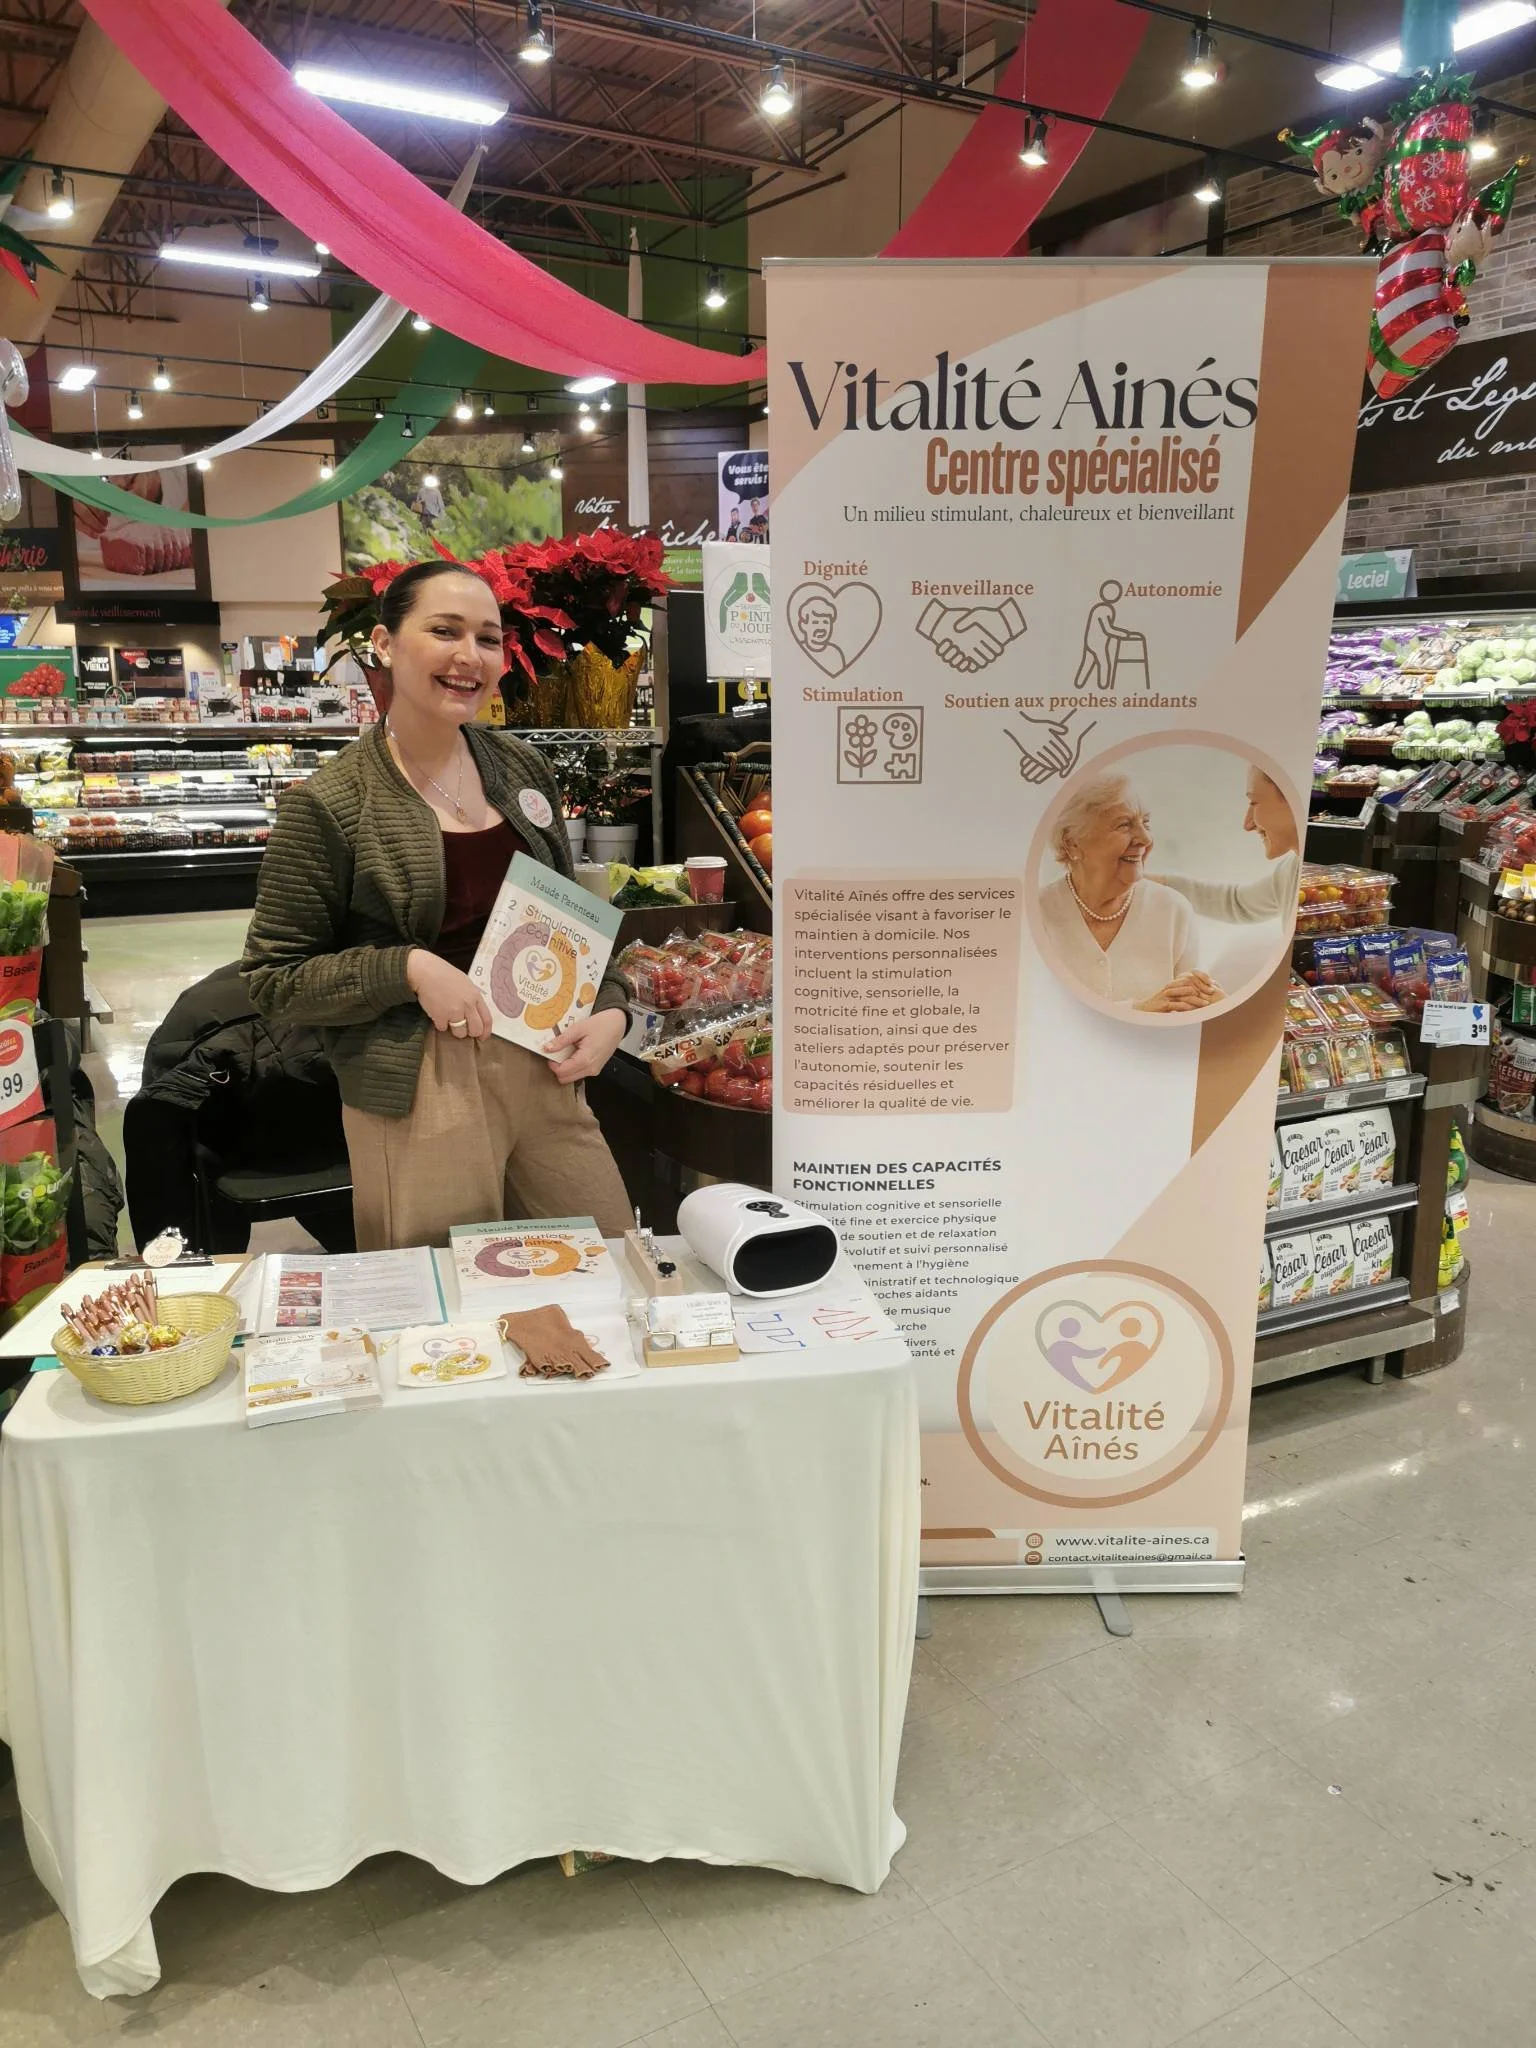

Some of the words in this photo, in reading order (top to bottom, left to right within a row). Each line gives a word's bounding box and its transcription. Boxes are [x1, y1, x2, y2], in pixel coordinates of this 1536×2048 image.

[787, 350, 1042, 432] Vitalité
[1053, 357, 1259, 430] Ainés
[1437, 438, 1479, 463] du
[728, 465, 750, 475] Vous
[926, 436, 1039, 495] Centre
[1046, 433, 1221, 505] spécialisé
[574, 497, 620, 514] Votre
[844, 505, 870, 522] Un
[874, 505, 925, 522] milieu
[931, 505, 1013, 524] stimulant,
[1019, 505, 1110, 522] chaleureux
[1116, 506, 1132, 521] et
[1138, 504, 1234, 521] bienveillant
[803, 560, 868, 580] Dignité
[912, 580, 1034, 597] Bienveillance
[1125, 581, 1222, 597] Autonomie
[802, 687, 904, 703] Stimulation
[944, 694, 1011, 709] Soutien
[1014, 697, 1044, 709] aux
[1049, 693, 1118, 711] proches
[1122, 693, 1197, 709] aindants
[530, 877, 560, 900] Maude
[560, 892, 600, 924] Parenteau
[795, 889, 845, 901] Vitalité
[892, 889, 924, 901] offre
[929, 889, 954, 900] des
[958, 888, 1015, 899] services
[795, 909, 871, 922] spécialisée
[876, 910, 918, 921] visant
[922, 908, 930, 920] à
[934, 909, 995, 920] favoriser
[1000, 908, 1011, 919] le
[525, 904, 589, 945] Stimulation
[526, 923, 578, 959] Cognitive
[795, 929, 858, 941] maintien
[862, 930, 870, 941] à
[875, 929, 938, 940] domicile.
[944, 928, 970, 939] Nos
[795, 948, 888, 960] interventions
[892, 948, 997, 961] personnalisées
[795, 966, 852, 979] incluent
[856, 968, 867, 979] la
[872, 967, 952, 979] stimulation
[795, 986, 862, 1000] cognitive,
[866, 986, 943, 998] sensorielle,
[948, 985, 959, 996] la
[795, 1006, 858, 1017] motricité
[862, 1006, 888, 1016] fine
[892, 1006, 906, 1016] et
[910, 1004, 965, 1018] globale,
[969, 1004, 980, 1015] la
[794, 1024, 882, 1037] socialisation,
[887, 1024, 918, 1035] ainsi
[922, 1026, 948, 1037] que
[953, 1023, 977, 1034] des
[794, 1043, 844, 1054] ateliers
[848, 1042, 904, 1056] adaptés
[908, 1044, 939, 1055] pour
[945, 1042, 1009, 1054] préserver
[795, 1060, 880, 1074] l'autonomie,
[884, 1061, 940, 1072] soutenir
[945, 1060, 963, 1070] les
[794, 1080, 859, 1092] capacités
[864, 1079, 936, 1091] résiduelles
[940, 1079, 954, 1089] et
[794, 1096, 859, 1109] améliorer
[864, 1099, 874, 1109] la
[879, 1097, 926, 1110] qualité
[931, 1096, 947, 1107] de
[952, 1096, 973, 1106] vie.
[1284, 1137, 1323, 1170] Caesar
[1325, 1140, 1355, 1168] César
[793, 1161, 871, 1175] MAINTIEN
[876, 1163, 908, 1174] DES
[912, 1158, 1001, 1173] CAPACITÉS
[1302, 1172, 1314, 1182] kit
[793, 1178, 935, 1192] FONCTIONNELLES
[866, 1201, 920, 1212] cognitive
[924, 1201, 935, 1209] et
[939, 1199, 1001, 1208] sensorielle
[850, 1216, 872, 1226] fine
[876, 1217, 887, 1225] et
[891, 1215, 939, 1224] exercice
[943, 1214, 997, 1228] physique
[841, 1232, 855, 1241] de
[858, 1231, 901, 1241] soutien
[906, 1231, 917, 1239] et
[921, 1230, 935, 1239] de
[939, 1229, 996, 1238] relaxation
[1354, 1224, 1391, 1257] Caesar
[889, 1247, 900, 1255] et
[904, 1245, 930, 1254] suivi
[934, 1243, 1008, 1255] personnalisé
[906, 1260, 913, 1269] à
[917, 1259, 969, 1272] l'hygiène
[1314, 1245, 1347, 1274] César
[1372, 1259, 1382, 1269] kit
[1275, 1254, 1308, 1283] César
[921, 1277, 932, 1285] et
[935, 1274, 1019, 1287] technologique
[915, 1289, 958, 1298] aidants
[901, 1306, 951, 1317] musique
[944, 1348, 955, 1356] et
[1024, 1400, 1165, 1431] Vitalité
[1043, 1433, 1139, 1460] Aînés
[1056, 1535, 1210, 1546] www.vitalite-aines.ca
